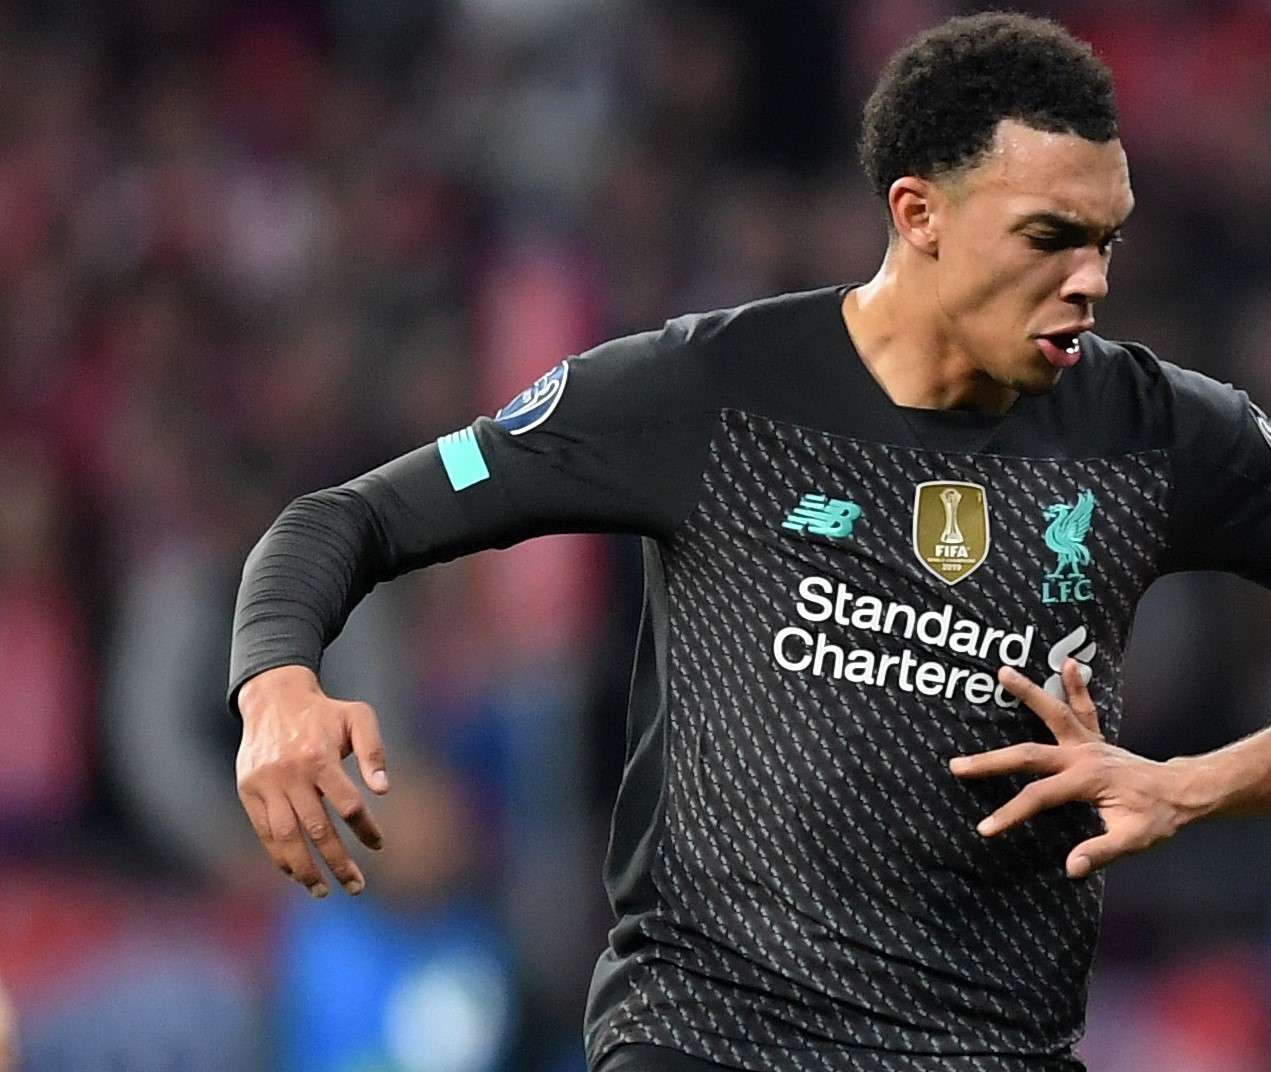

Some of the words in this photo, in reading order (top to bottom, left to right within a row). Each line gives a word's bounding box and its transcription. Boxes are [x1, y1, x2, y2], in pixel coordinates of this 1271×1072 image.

[935, 545, 969, 558] FIFA
[1042, 579, 1094, 603] LFC
[796, 576, 1034, 668] Standard
